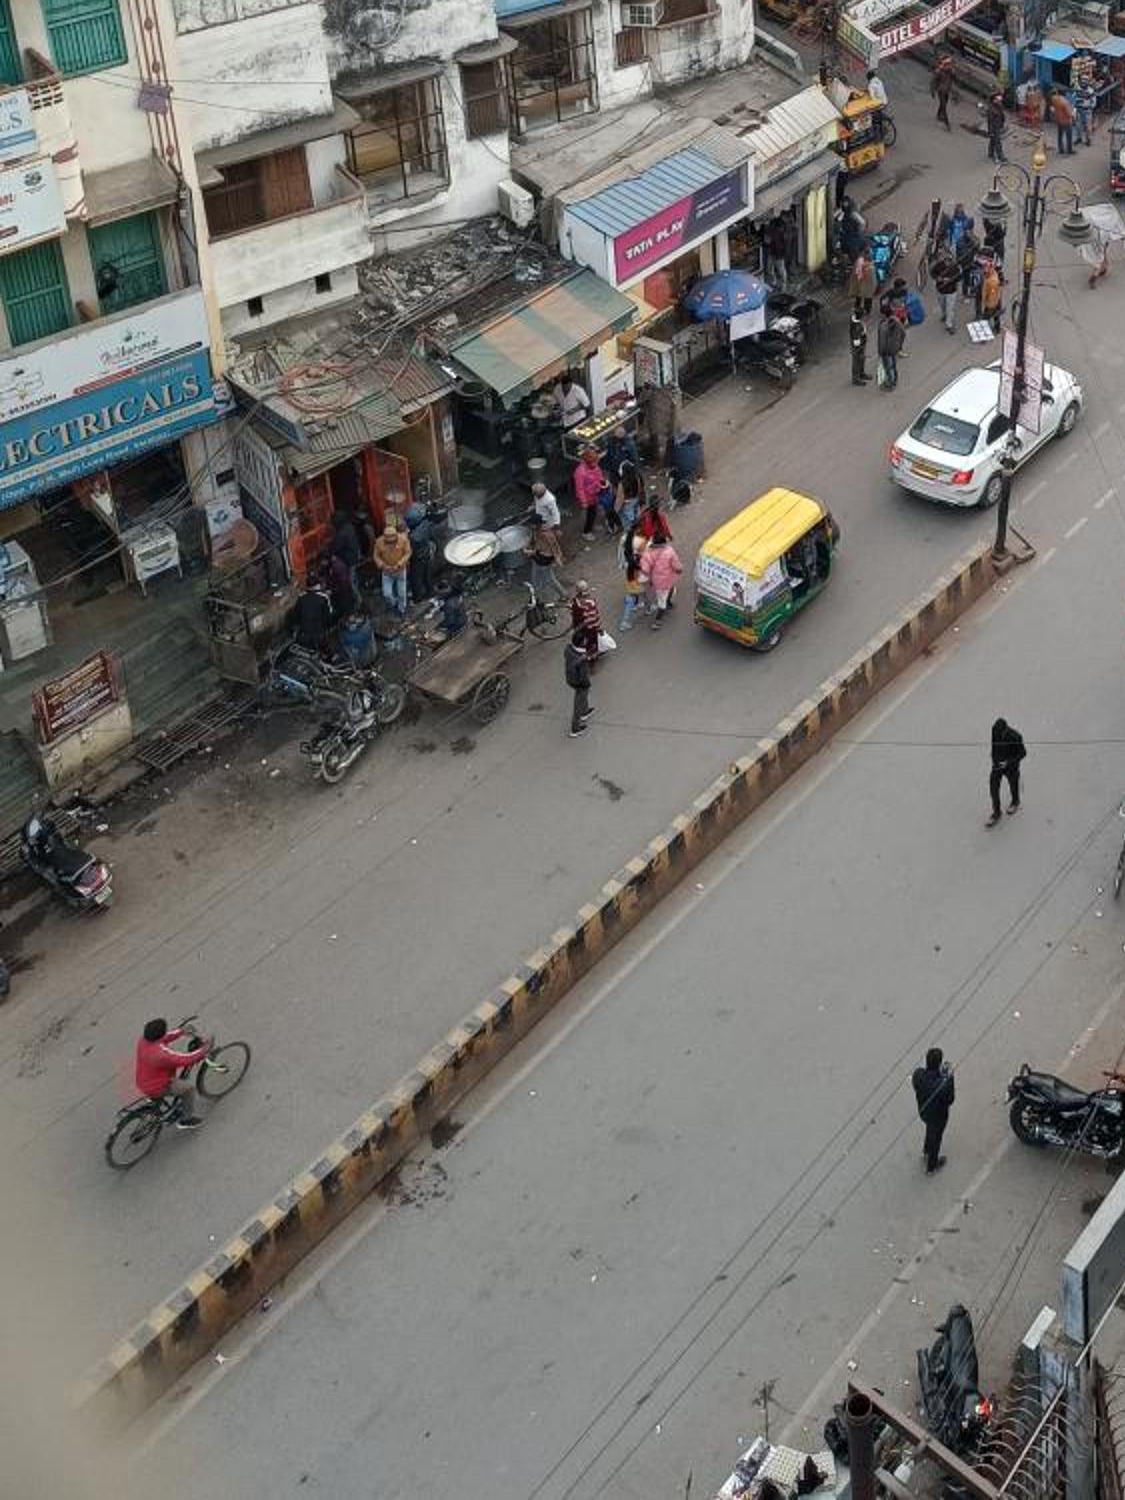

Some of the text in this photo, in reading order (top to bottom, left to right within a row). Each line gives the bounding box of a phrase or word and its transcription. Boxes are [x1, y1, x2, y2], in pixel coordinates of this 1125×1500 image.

[879, 23, 916, 50] OTEL
[624, 217, 685, 262] TATA PLAY
